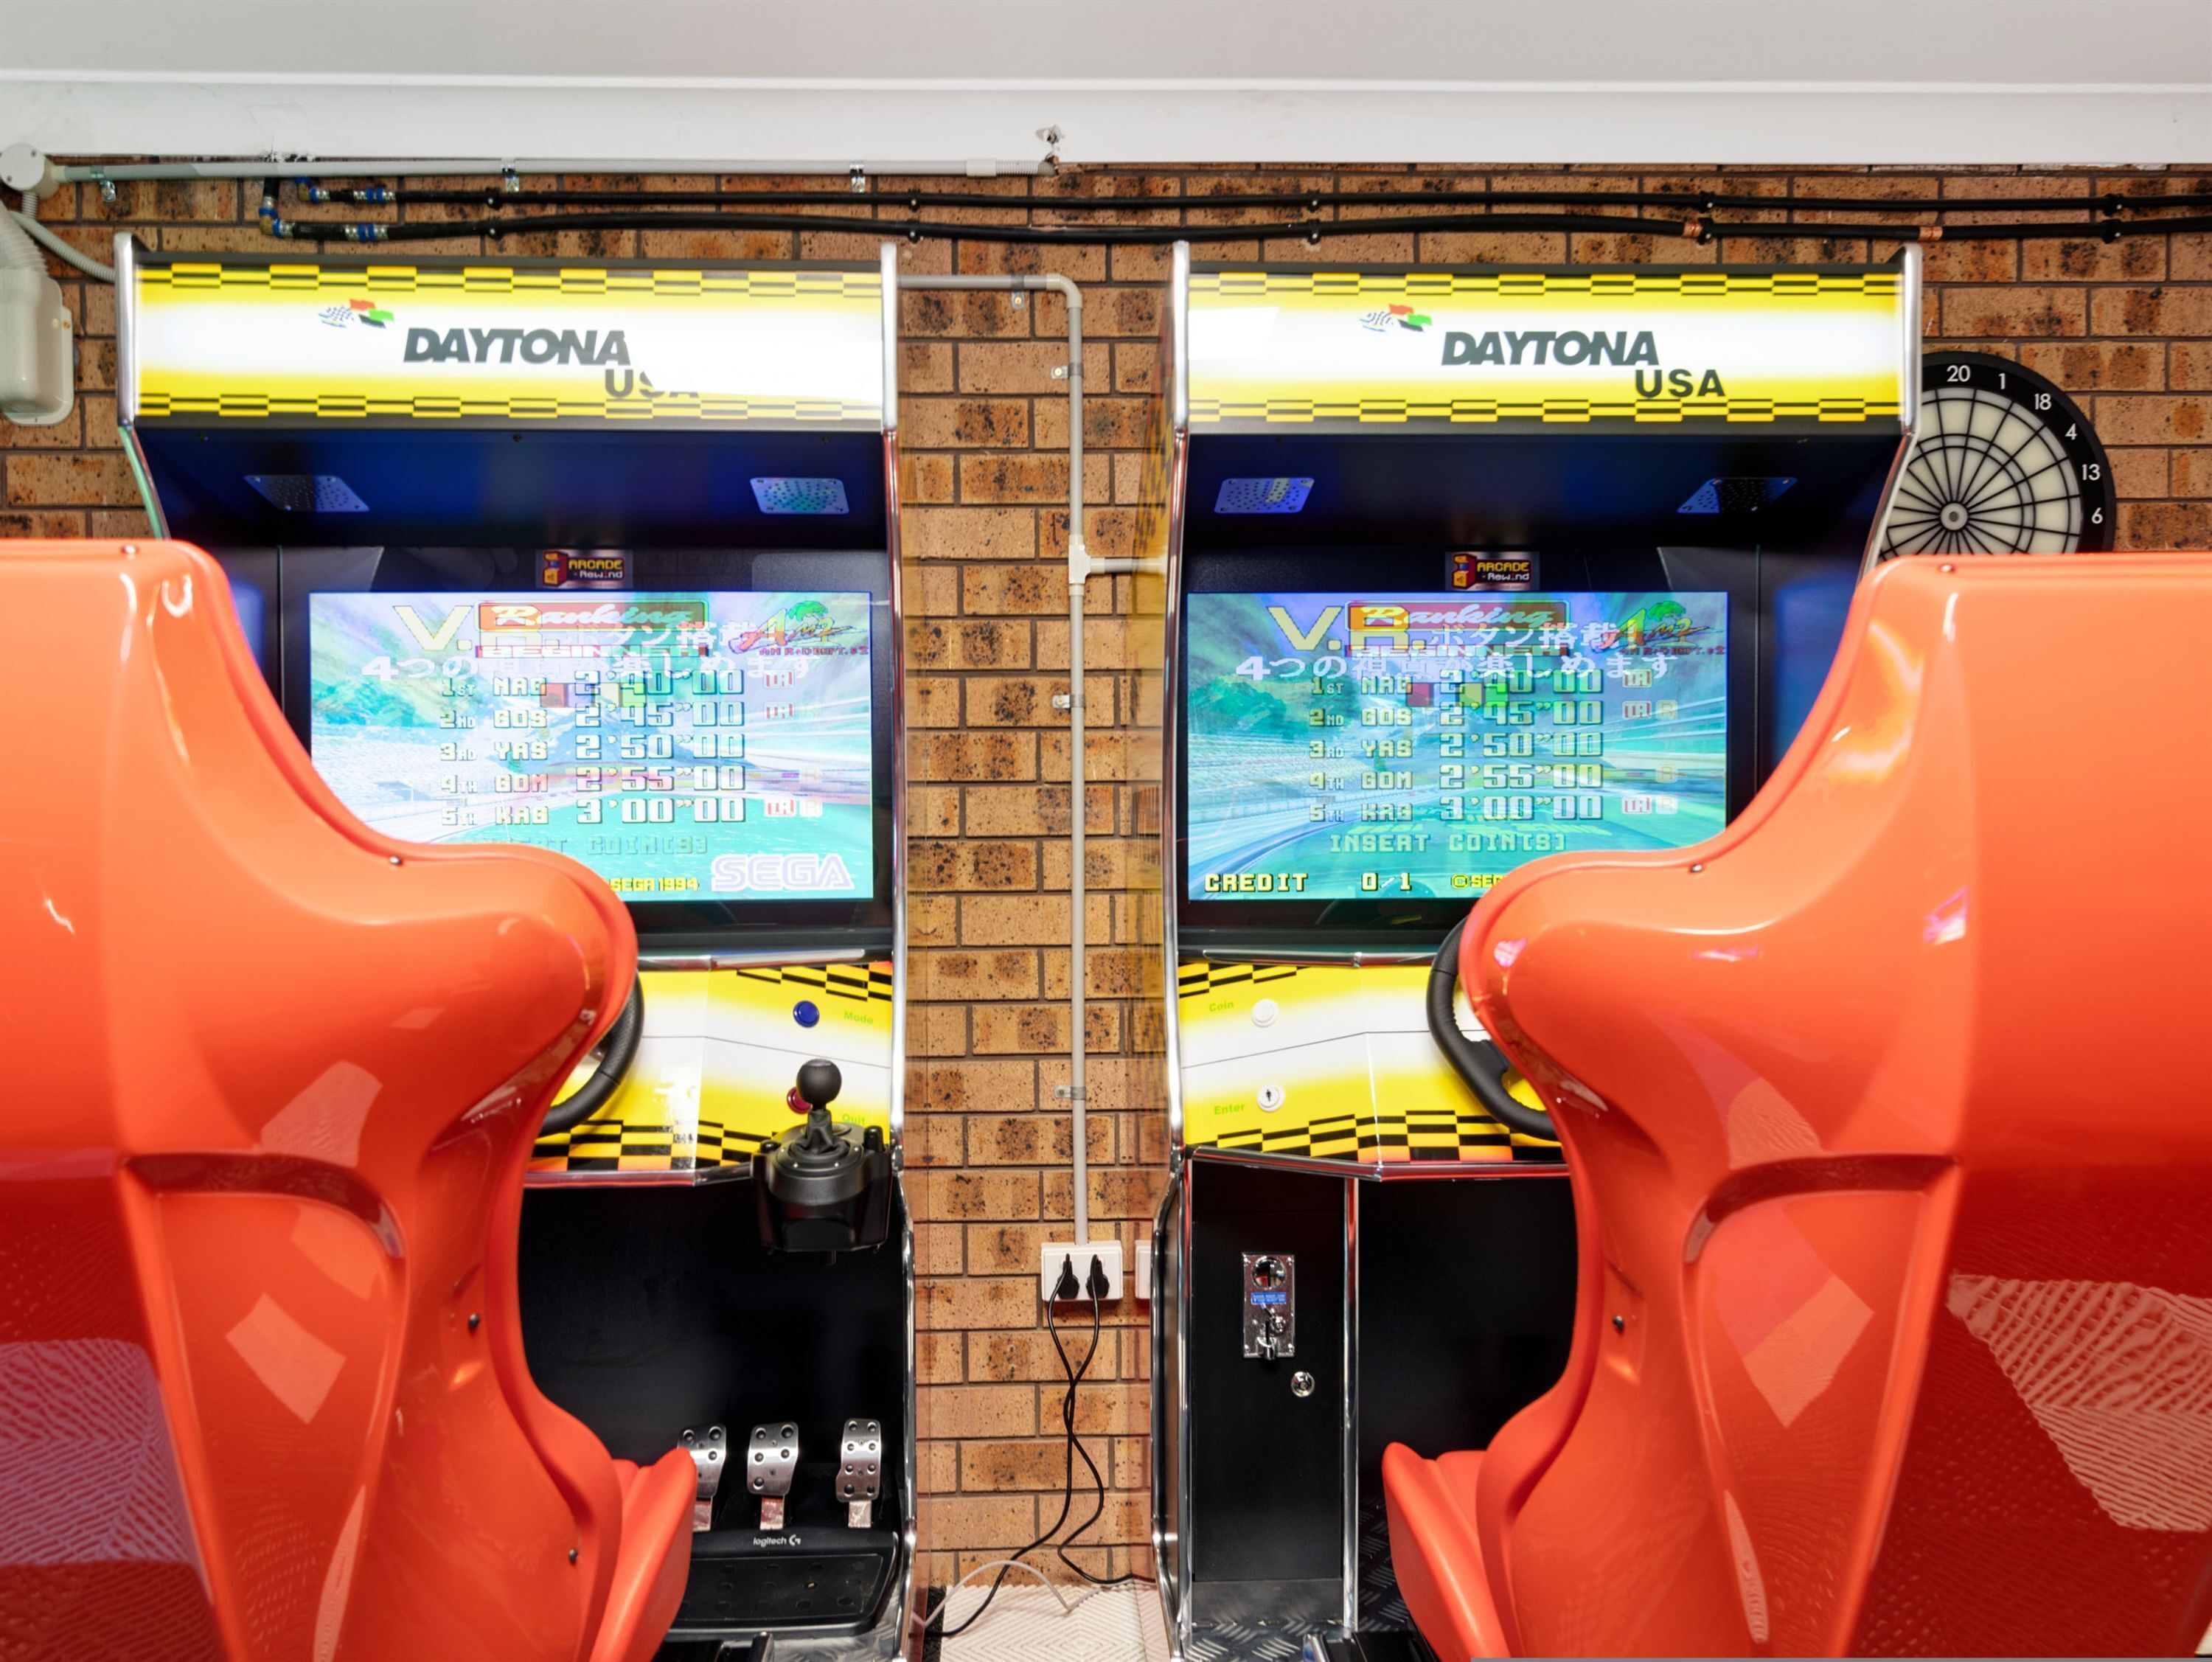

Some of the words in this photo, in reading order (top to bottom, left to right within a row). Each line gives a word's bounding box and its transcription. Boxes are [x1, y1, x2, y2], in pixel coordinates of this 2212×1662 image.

[403, 327, 630, 366] DAYTONA
[1441, 330, 1659, 366] DAYTONA
[1947, 365, 1971, 382] 20
[1998, 373, 2006, 390] 1
[605, 369, 700, 398] US
[1635, 369, 1726, 398] USA
[2034, 393, 2052, 410] 18
[2065, 424, 2077, 440] 4
[2081, 464, 2101, 481] 13
[2091, 508, 2103, 524] 6
[568, 559, 622, 570] ARCADE
[1477, 562, 1529, 572] ARCADE
[494, 709, 547, 729] GOS
[1362, 708, 1413, 726] GOS
[494, 742, 548, 761] YAS
[1362, 740, 1413, 758] YAS
[495, 773, 549, 793] GOM
[1362, 771, 1413, 790] GOM
[495, 806, 549, 825] KAG
[1362, 803, 1413, 822] KAG
[1329, 834, 1430, 853] INSERT
[710, 852, 855, 892] SEGA
[658, 877, 699, 891] 1994
[1204, 872, 1309, 893] CREDIT
[1208, 1001, 1234, 1012] Coin
[844, 1011, 874, 1025] Mode
[1214, 1103, 1245, 1116] Enter
[842, 1113, 866, 1126] Quit
[753, 1536, 787, 1548] logitech
